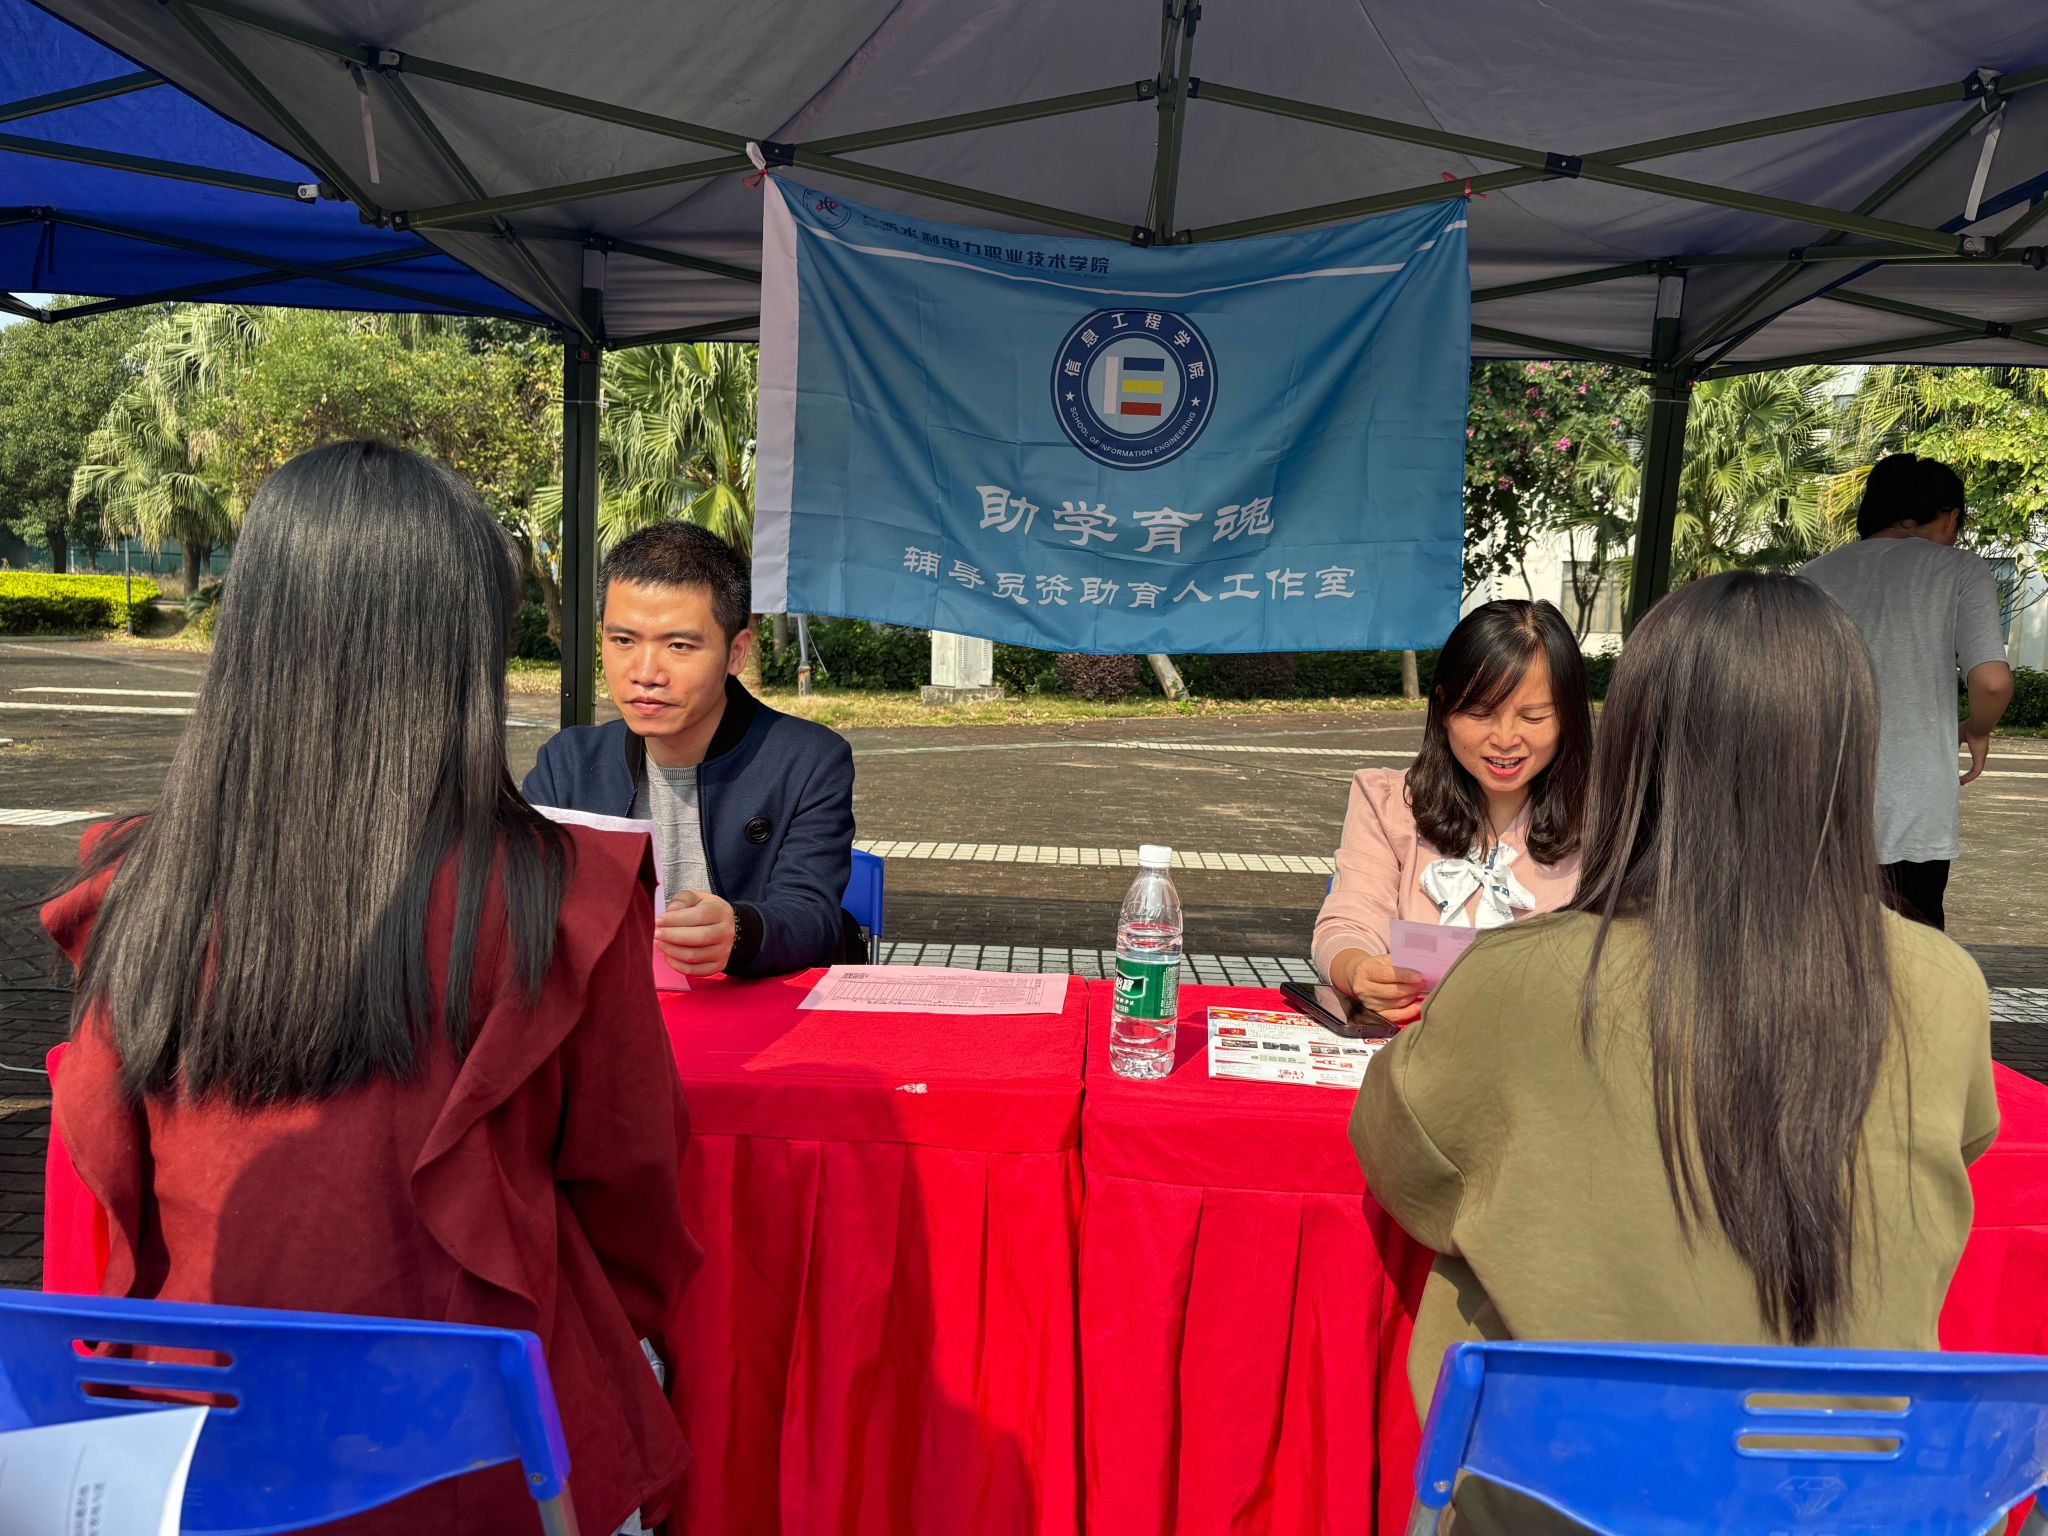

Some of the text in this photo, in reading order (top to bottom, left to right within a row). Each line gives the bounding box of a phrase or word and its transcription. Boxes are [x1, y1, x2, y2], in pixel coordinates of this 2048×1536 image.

[863, 213, 1110, 274] 西水利电力职业技术学院
[1064, 312, 1205, 380] 信息工程学院
[1069, 406, 1197, 458] SCHOOL OF INFORMATION ENGINEERING
[975, 484, 1275, 554] 助学育魂
[902, 545, 1357, 609] 辅导员资助育人工作室
